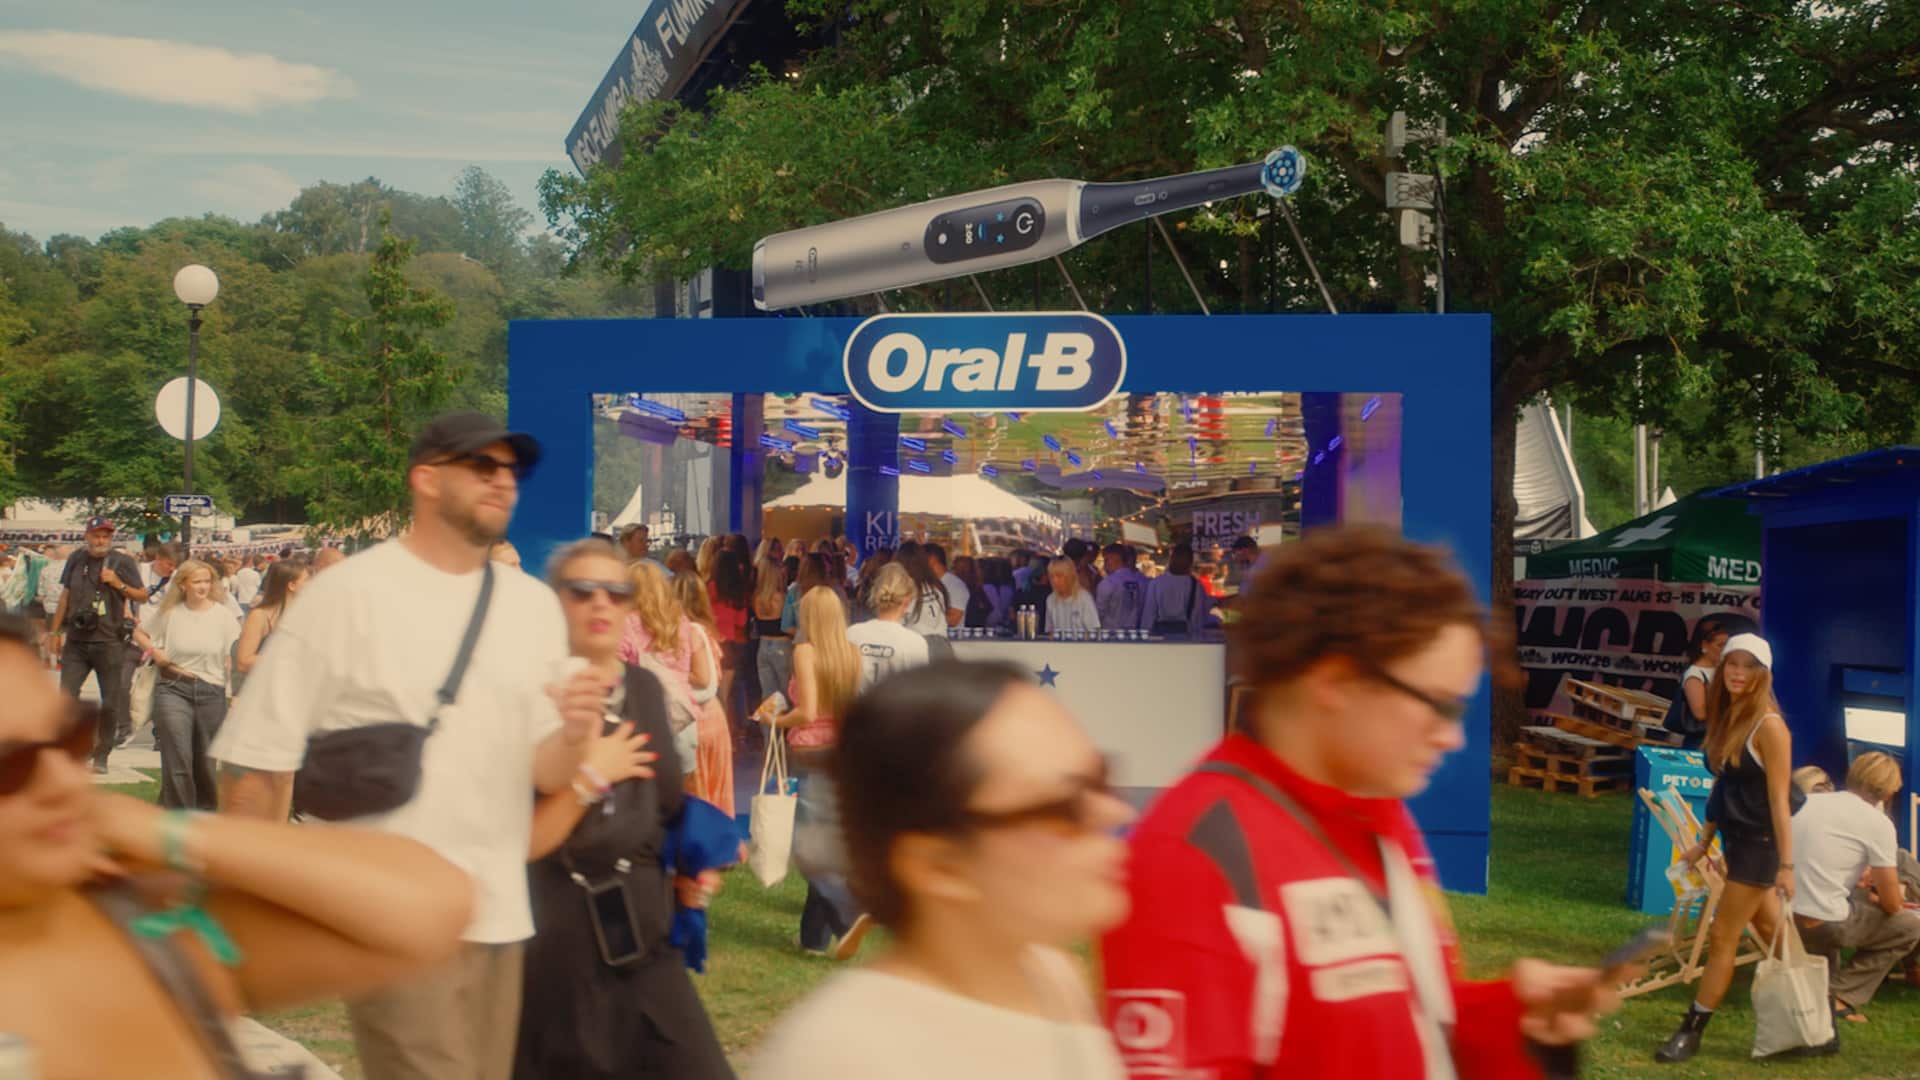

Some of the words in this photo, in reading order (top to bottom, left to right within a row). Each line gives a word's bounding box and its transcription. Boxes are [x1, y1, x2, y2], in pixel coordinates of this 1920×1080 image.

[867, 331, 1096, 393] Oral-B
[1568, 557, 1620, 578] MEDIC
[1544, 588, 1578, 600] OUT
[1578, 588, 1618, 601] WEST
[1619, 589, 1652, 602] AUG
[1699, 591, 1752, 608] WAY
